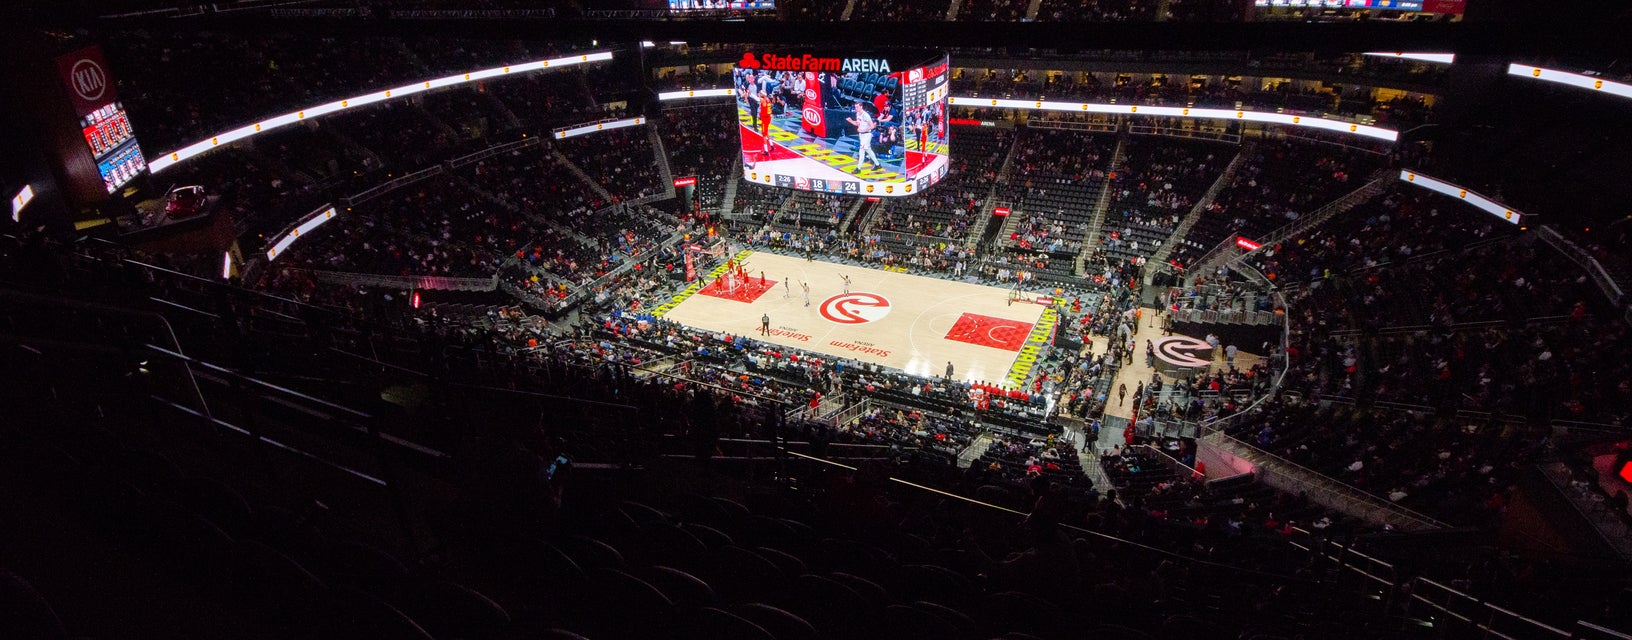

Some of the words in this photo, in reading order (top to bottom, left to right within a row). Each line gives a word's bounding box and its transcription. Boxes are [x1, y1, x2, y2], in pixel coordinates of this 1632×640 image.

[841, 58, 891, 72] ARENA
[75, 67, 103, 94] KIA
[804, 111, 819, 123] KIA
[778, 175, 792, 183] 2:26
[812, 179, 824, 188] 18
[844, 182, 857, 191] 24
